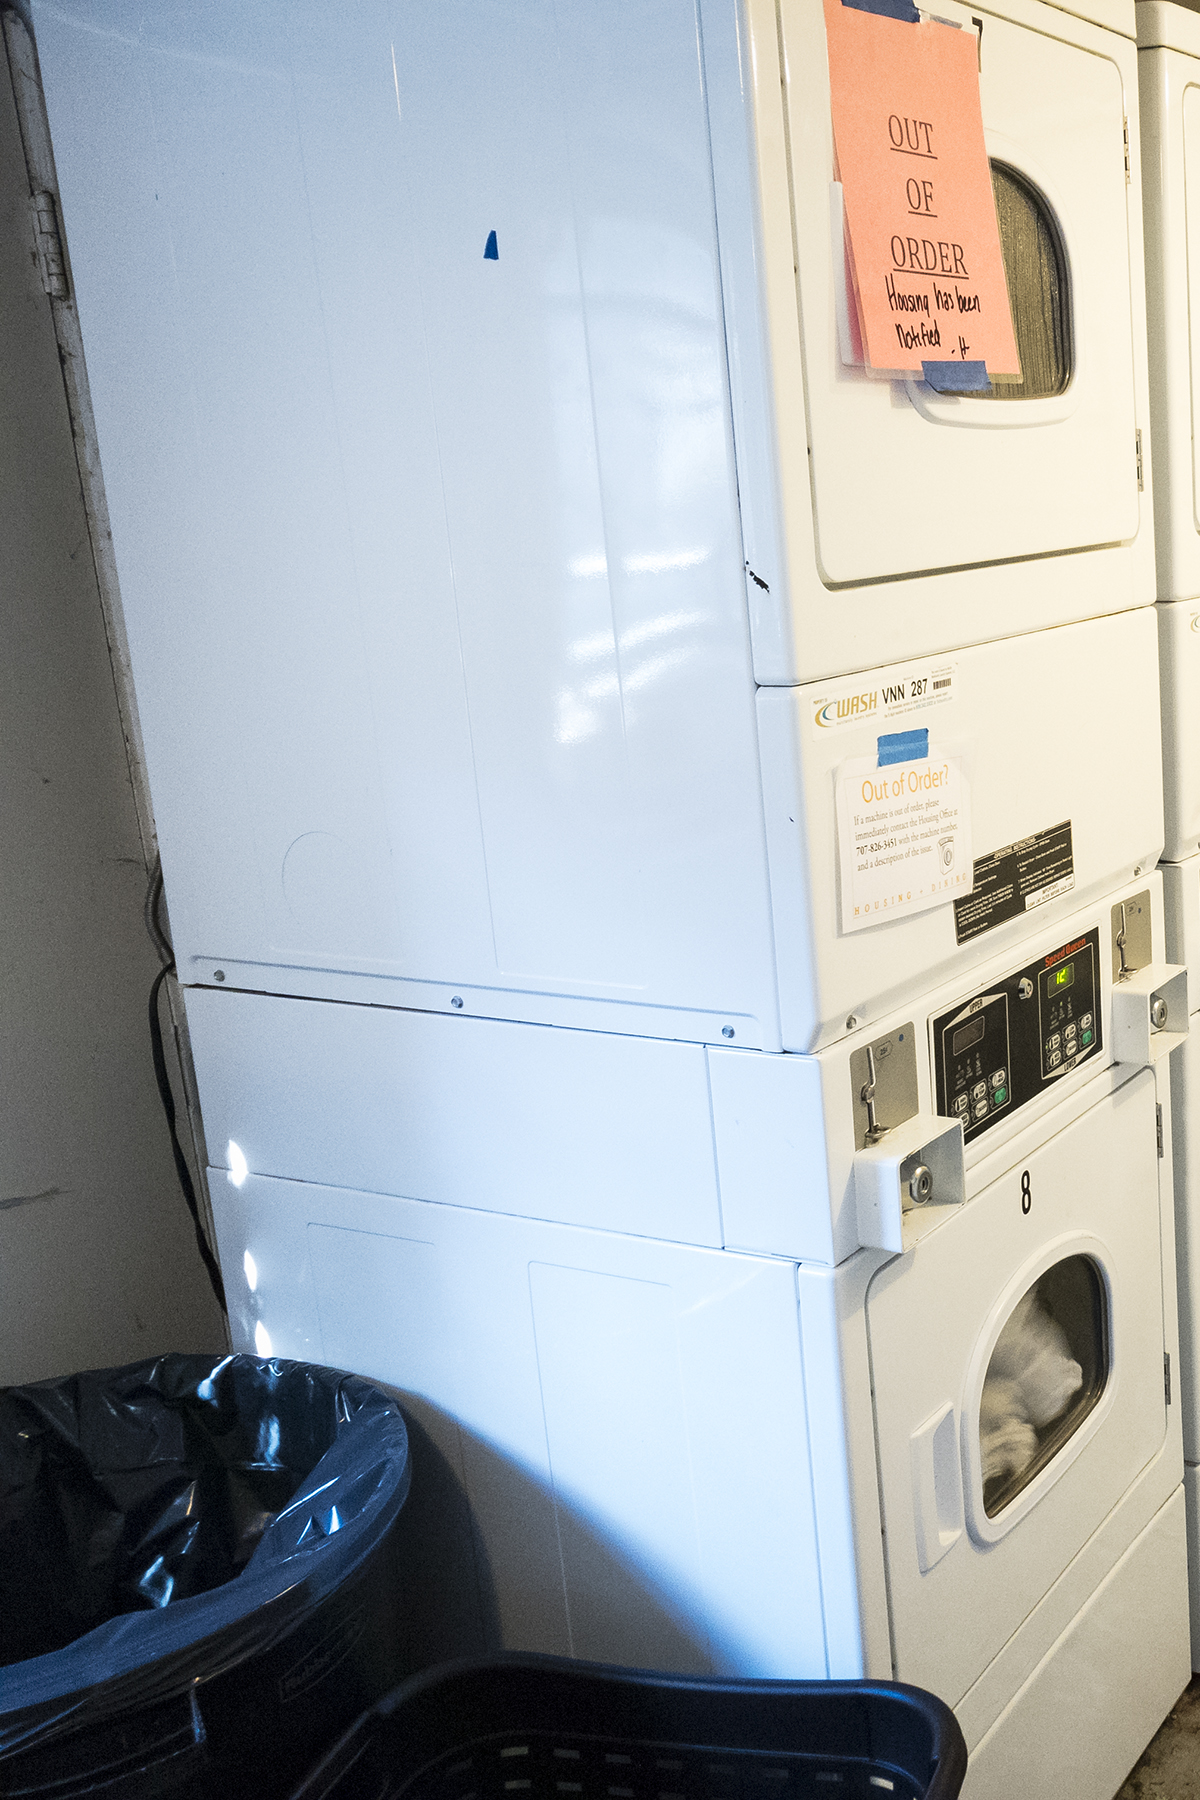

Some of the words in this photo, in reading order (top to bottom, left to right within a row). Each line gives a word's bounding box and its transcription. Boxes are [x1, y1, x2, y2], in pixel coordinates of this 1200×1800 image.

[971, 16, 983, 73] 7
[888, 114, 933, 154] OUT
[906, 178, 933, 213] OF
[891, 235, 969, 275] ORDER
[885, 273, 930, 318] Housing
[933, 282, 954, 311] has
[955, 285, 981, 314] been
[836, 691, 878, 718] WASH
[881, 684, 905, 704] VNN
[911, 678, 928, 697] 287
[862, 780, 889, 803] Out
[892, 772, 905, 797] of
[908, 764, 949, 793] Order?
[853, 814, 860, 826] If
[865, 811, 888, 823] machine
[889, 809, 894, 818] is
[894, 808, 903, 816] out
[904, 803, 909, 814] of
[925, 799, 939, 811] please
[855, 824, 889, 841] immediately
[890, 822, 909, 833] contact
[909, 817, 918, 827] the
[918, 813, 939, 825] Housing
[939, 808, 953, 819] Office
[856, 838, 897, 856] 707-826-3451
[899, 834, 910, 844] with
[911, 832, 919, 842] the
[920, 828, 939, 839] machine
[857, 859, 869, 871] and
[874, 852, 904, 866] description
[905, 848, 911, 858] of
[911, 847, 919, 857] the
[854, 891, 911, 915] HOUSING
[931, 872, 967, 892] DINING
[1045, 947, 1065, 968] Speed
[1066, 938, 1086, 954] Queen
[970, 998, 983, 1013] UPPER
[1021, 1170, 1031, 1215] 8
